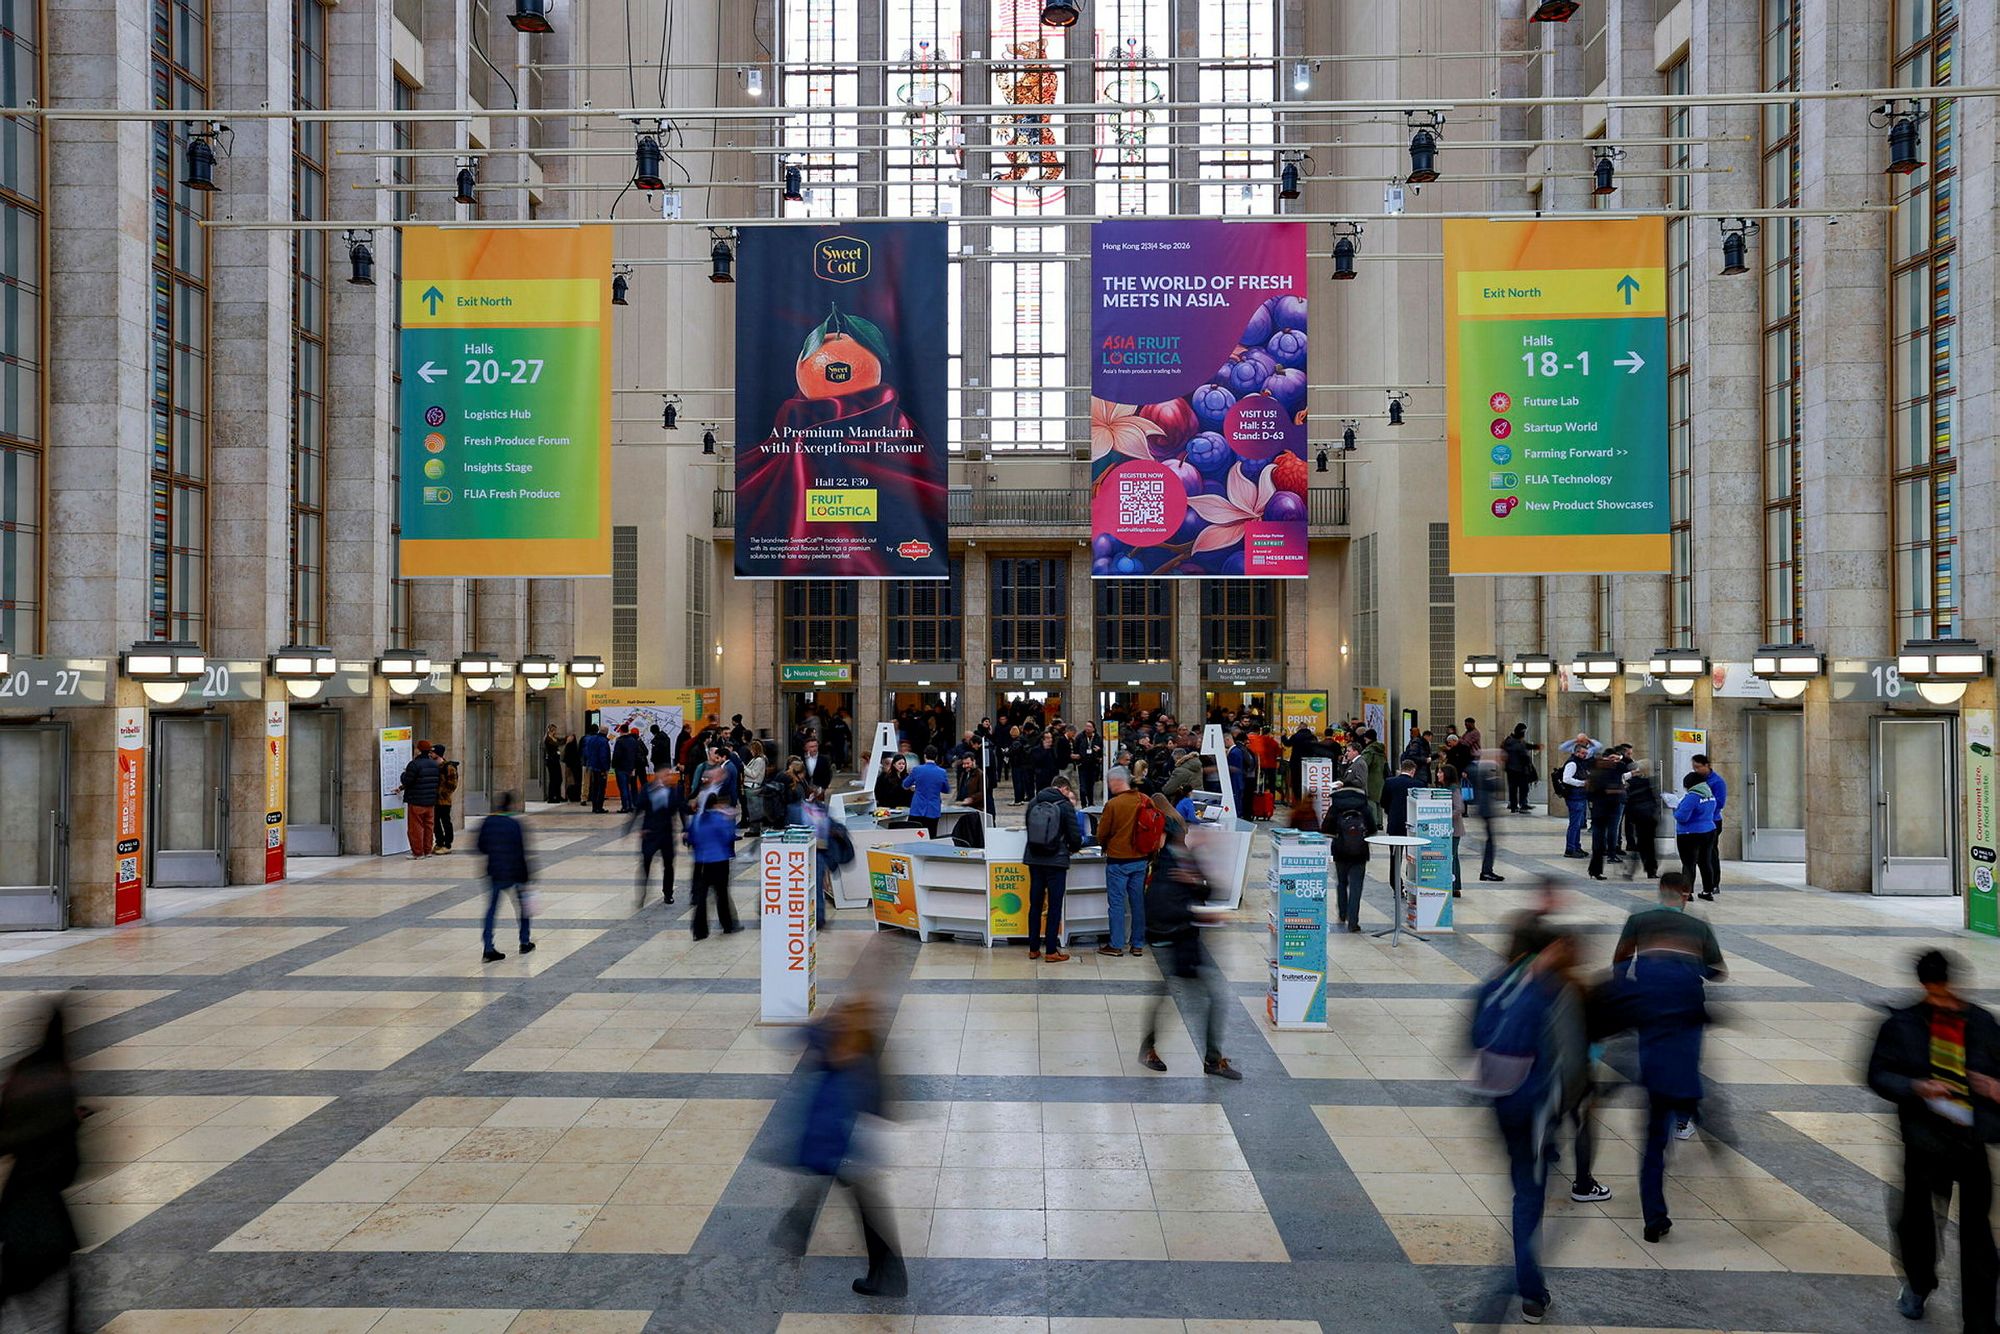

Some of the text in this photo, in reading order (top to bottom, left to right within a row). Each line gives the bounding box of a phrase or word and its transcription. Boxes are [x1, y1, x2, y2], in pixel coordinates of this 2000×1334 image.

[822, 245, 861, 259] Sweet
[1103, 242, 1120, 251] Hong
[1122, 242, 1139, 251] Kong
[1159, 242, 1171, 251] Sep
[828, 259, 857, 274] Cott
[1103, 276, 1292, 290] THE WORLD OF FRESH
[1484, 288, 1541, 298] Exit North
[457, 296, 512, 306] Exit North
[1103, 293, 1229, 307] MEETS IN ASIA.
[1103, 336, 1180, 349] ASIA FRUIT
[1524, 336, 1553, 346] Halls
[465, 343, 493, 354] Halls
[1103, 351, 1181, 365] LOGISTICA
[828, 366, 848, 374] Sweet
[1521, 352, 1589, 377] 18-1
[465, 360, 544, 385] 20-27
[1524, 396, 1579, 406] Future Lab
[465, 410, 531, 421] Logistics Hub
[1240, 421, 1260, 429] Hall:
[1524, 422, 1598, 433] Startup World
[770, 427, 914, 438] A Premium Mandarin
[1233, 432, 1284, 440] Stand: D-63
[464, 436, 570, 446] Fresh Produce Forum
[760, 442, 924, 455] with Exceptional Flavour
[1524, 448, 1567, 459] Farming
[1570, 448, 1613, 457] Forward
[464, 462, 532, 474] Insights Stage
[836, 478, 849, 487] 22,
[1525, 474, 1612, 485] FLIA Technology
[464, 489, 560, 499] FLIA Fresh Produce
[812, 495, 843, 504] FRUIT
[1526, 500, 1654, 510] New Product Showcases
[812, 506, 871, 516] LOGISTICA
[1217, 666, 1251, 675] Ausgang
[55, 671, 80, 696] 27
[202, 666, 228, 696] 20
[1872, 666, 1900, 697] 18
[1983, 830, 1990, 842] no
[765, 851, 781, 914] GUIDE
[1296, 880, 1323, 889] FREE
[1296, 889, 1326, 898] COPY
[788, 851, 804, 971] EXHIBITION
